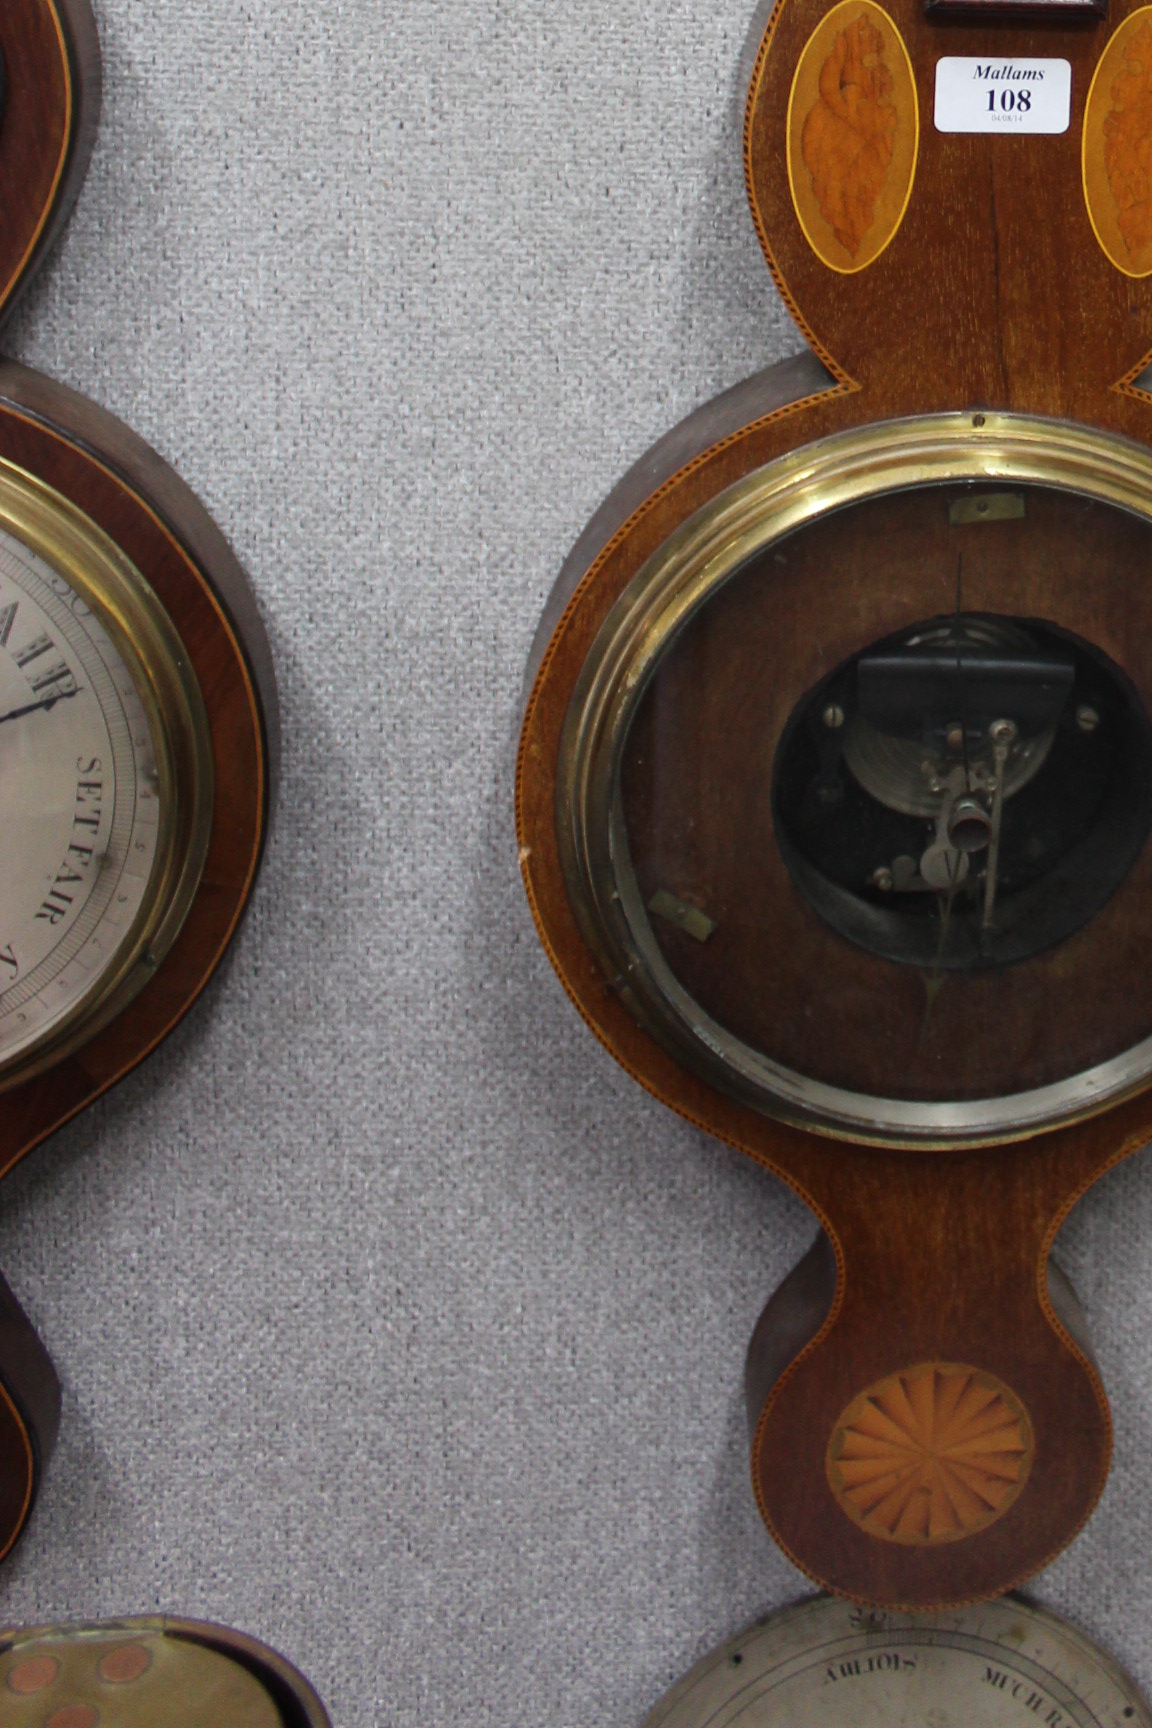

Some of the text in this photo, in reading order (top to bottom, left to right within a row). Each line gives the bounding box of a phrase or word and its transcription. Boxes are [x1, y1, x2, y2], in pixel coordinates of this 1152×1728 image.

[973, 65, 1045, 81] Mallams
[985, 89, 1032, 112] 108
[991, 114, 1023, 123] 04/08/14
[34, 756, 102, 925] SET FAIR
